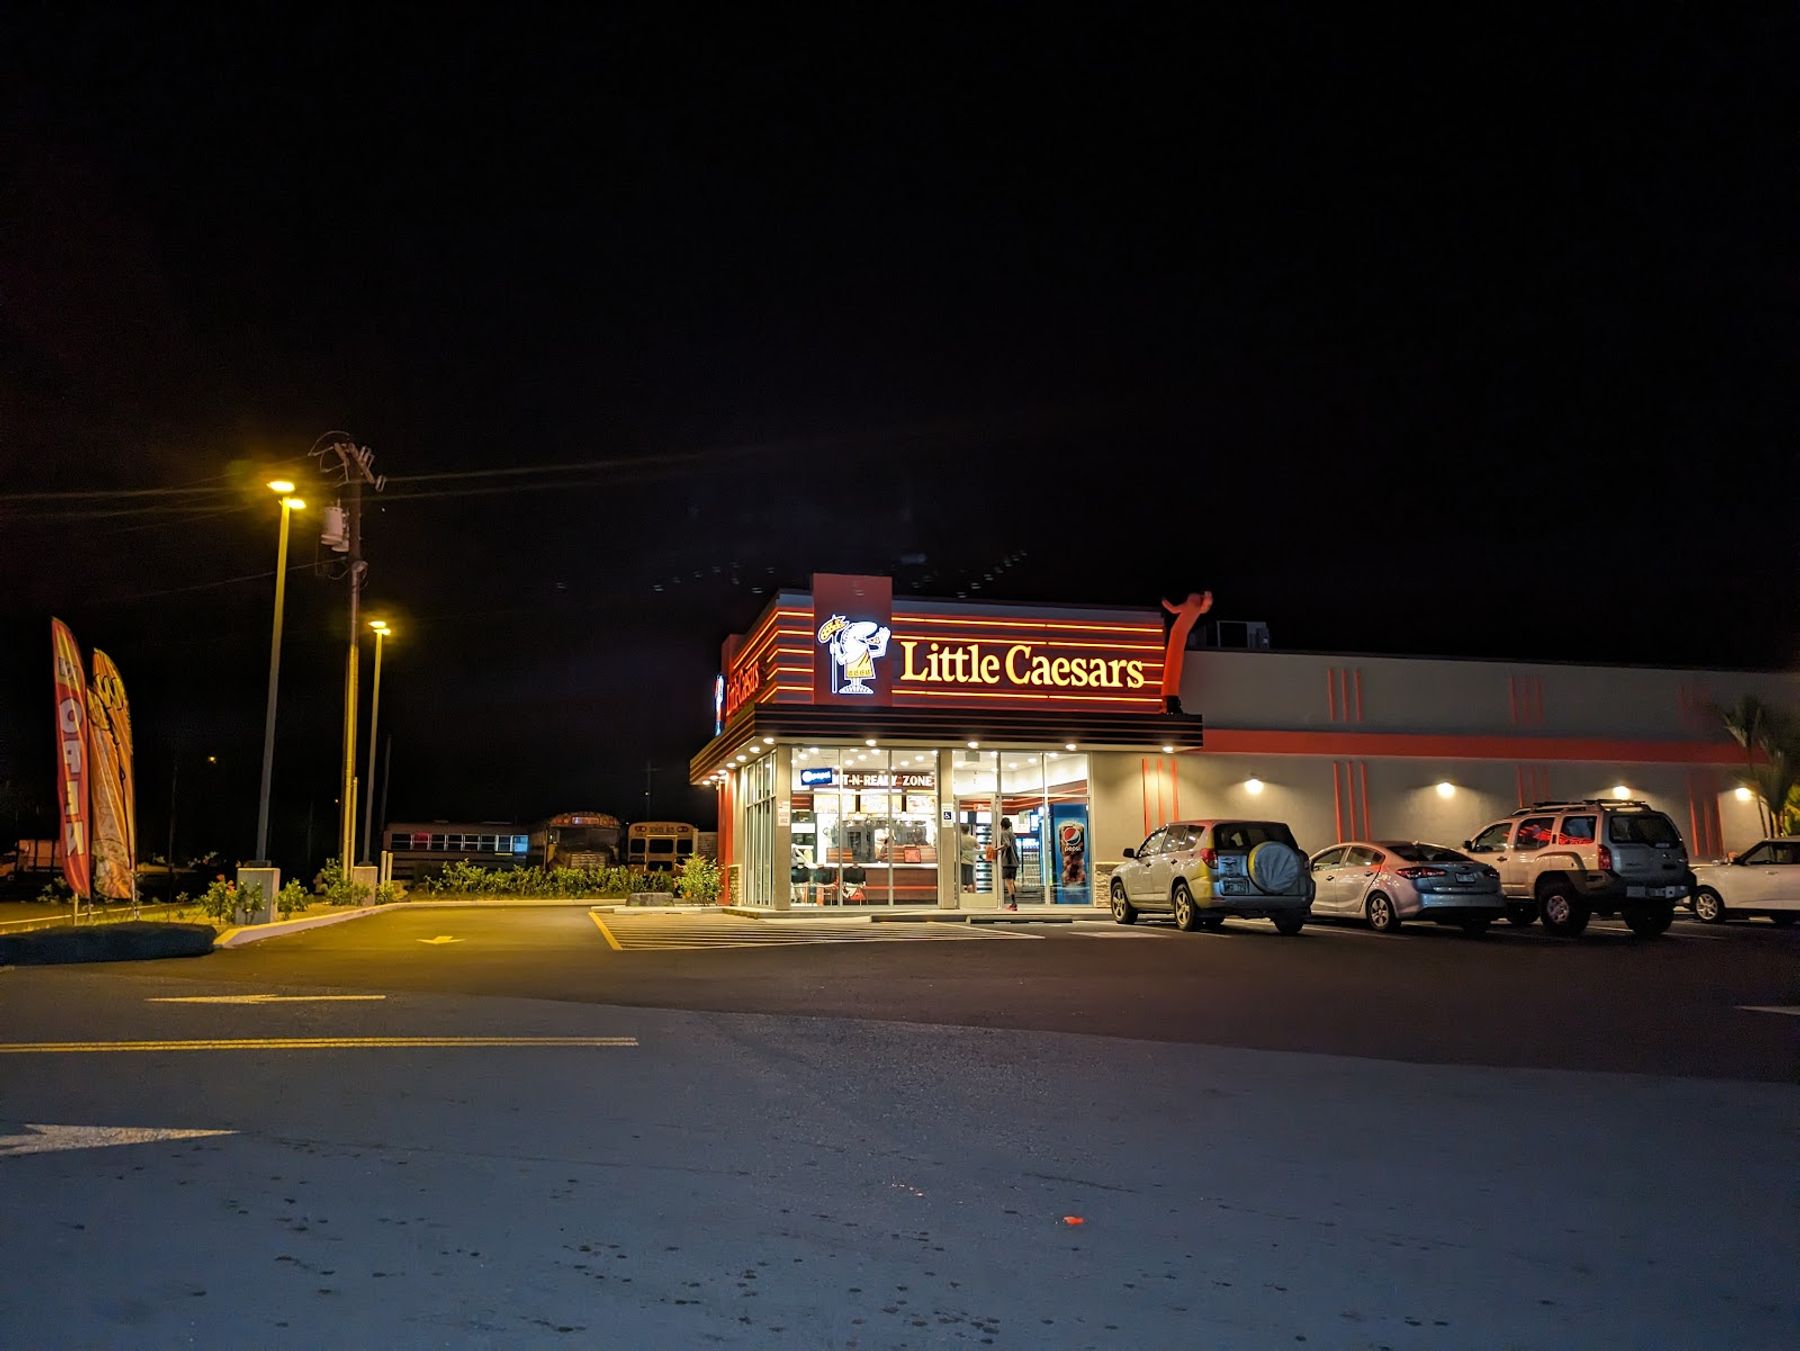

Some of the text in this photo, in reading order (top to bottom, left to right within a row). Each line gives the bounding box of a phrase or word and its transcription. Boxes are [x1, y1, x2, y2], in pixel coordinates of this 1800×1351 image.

[900, 641, 1145, 689] Little Caesars
[903, 775, 933, 787] ZONE
